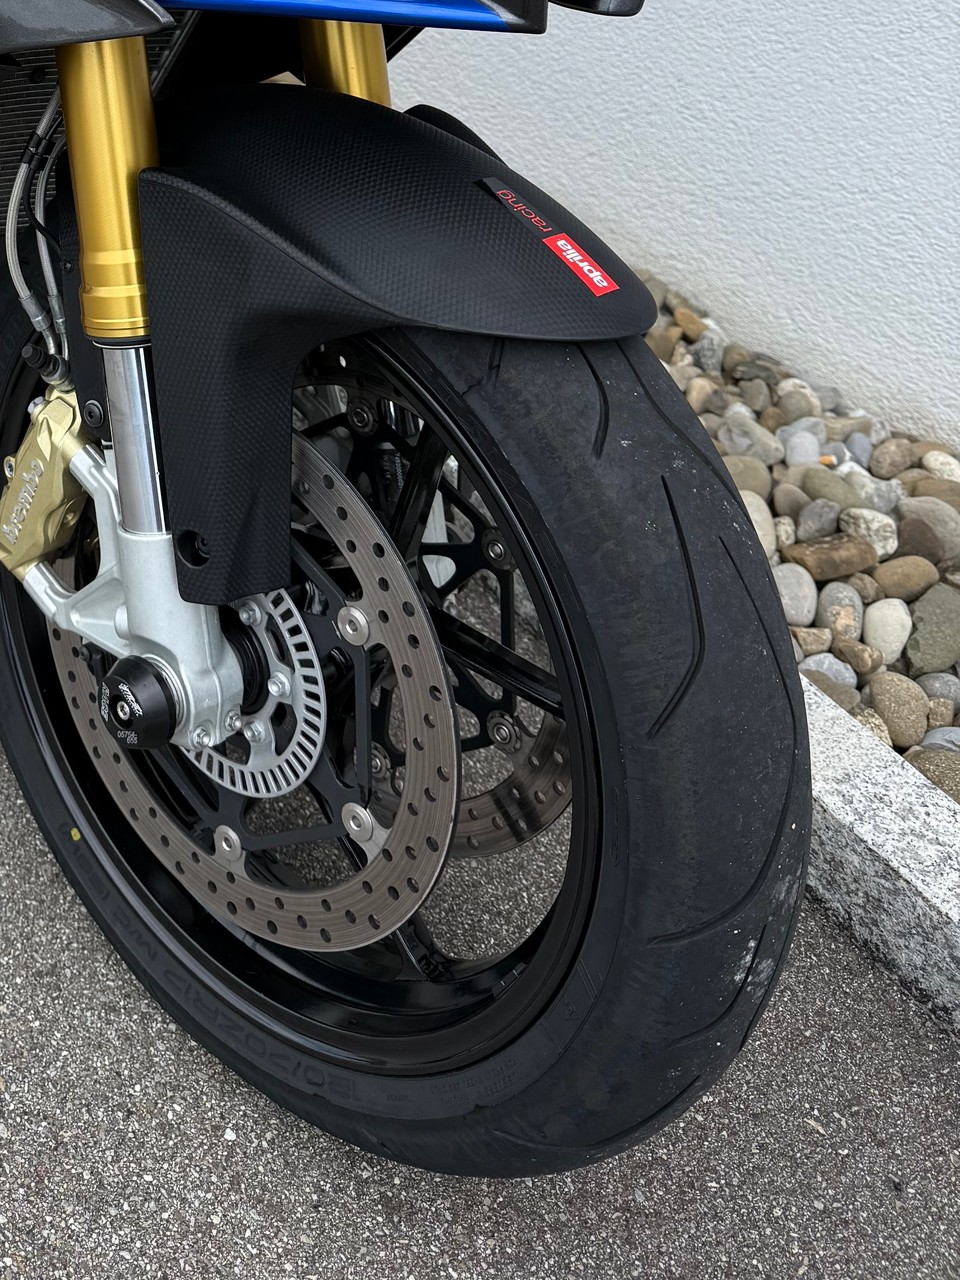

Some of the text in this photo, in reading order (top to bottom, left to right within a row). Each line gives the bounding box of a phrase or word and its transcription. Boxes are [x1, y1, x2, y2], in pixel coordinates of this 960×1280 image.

[496, 189, 609, 288] aprilia racing
[0, 458, 45, 545] brembo
